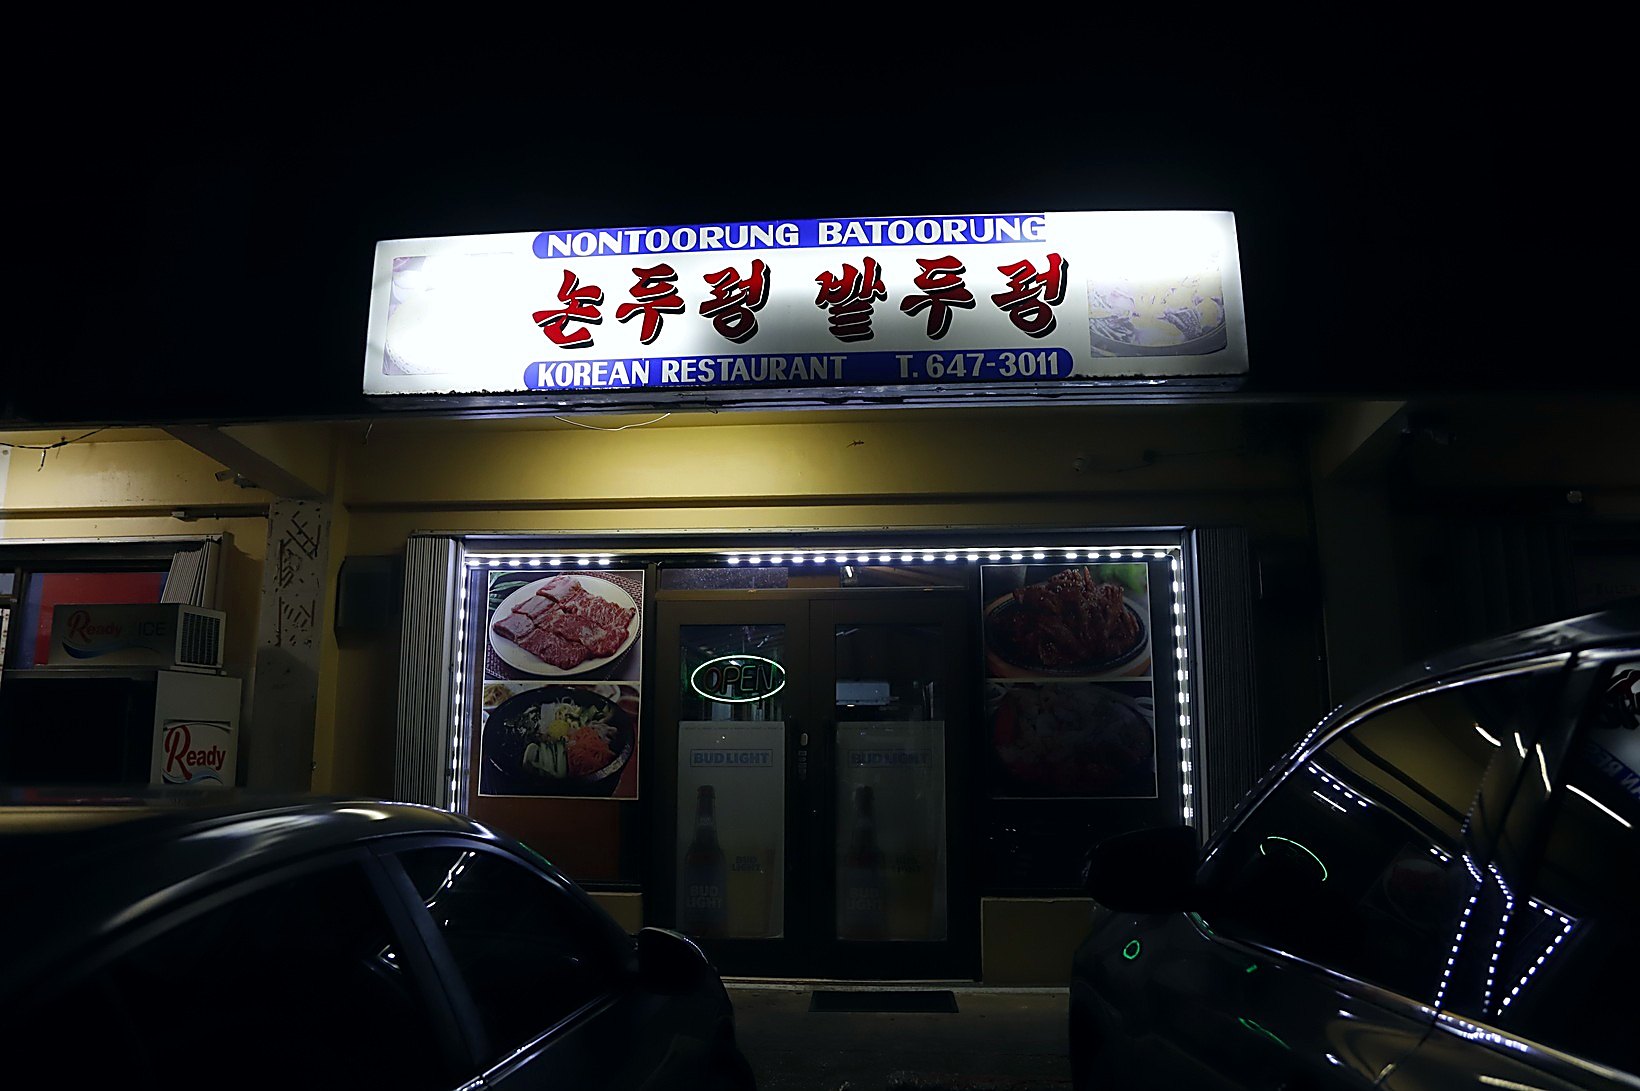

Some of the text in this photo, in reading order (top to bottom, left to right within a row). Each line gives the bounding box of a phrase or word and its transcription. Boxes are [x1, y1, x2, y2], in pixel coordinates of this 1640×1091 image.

[547, 216, 1046, 257] NONTOORUNG BATOORUNG
[532, 258, 771, 350] 논두렁
[537, 351, 1059, 387] KOREAN RESTAURANT T. 647-3011
[68, 610, 166, 643] Ready ICE
[703, 664, 774, 695] OPEN
[165, 725, 226, 781] Ready
